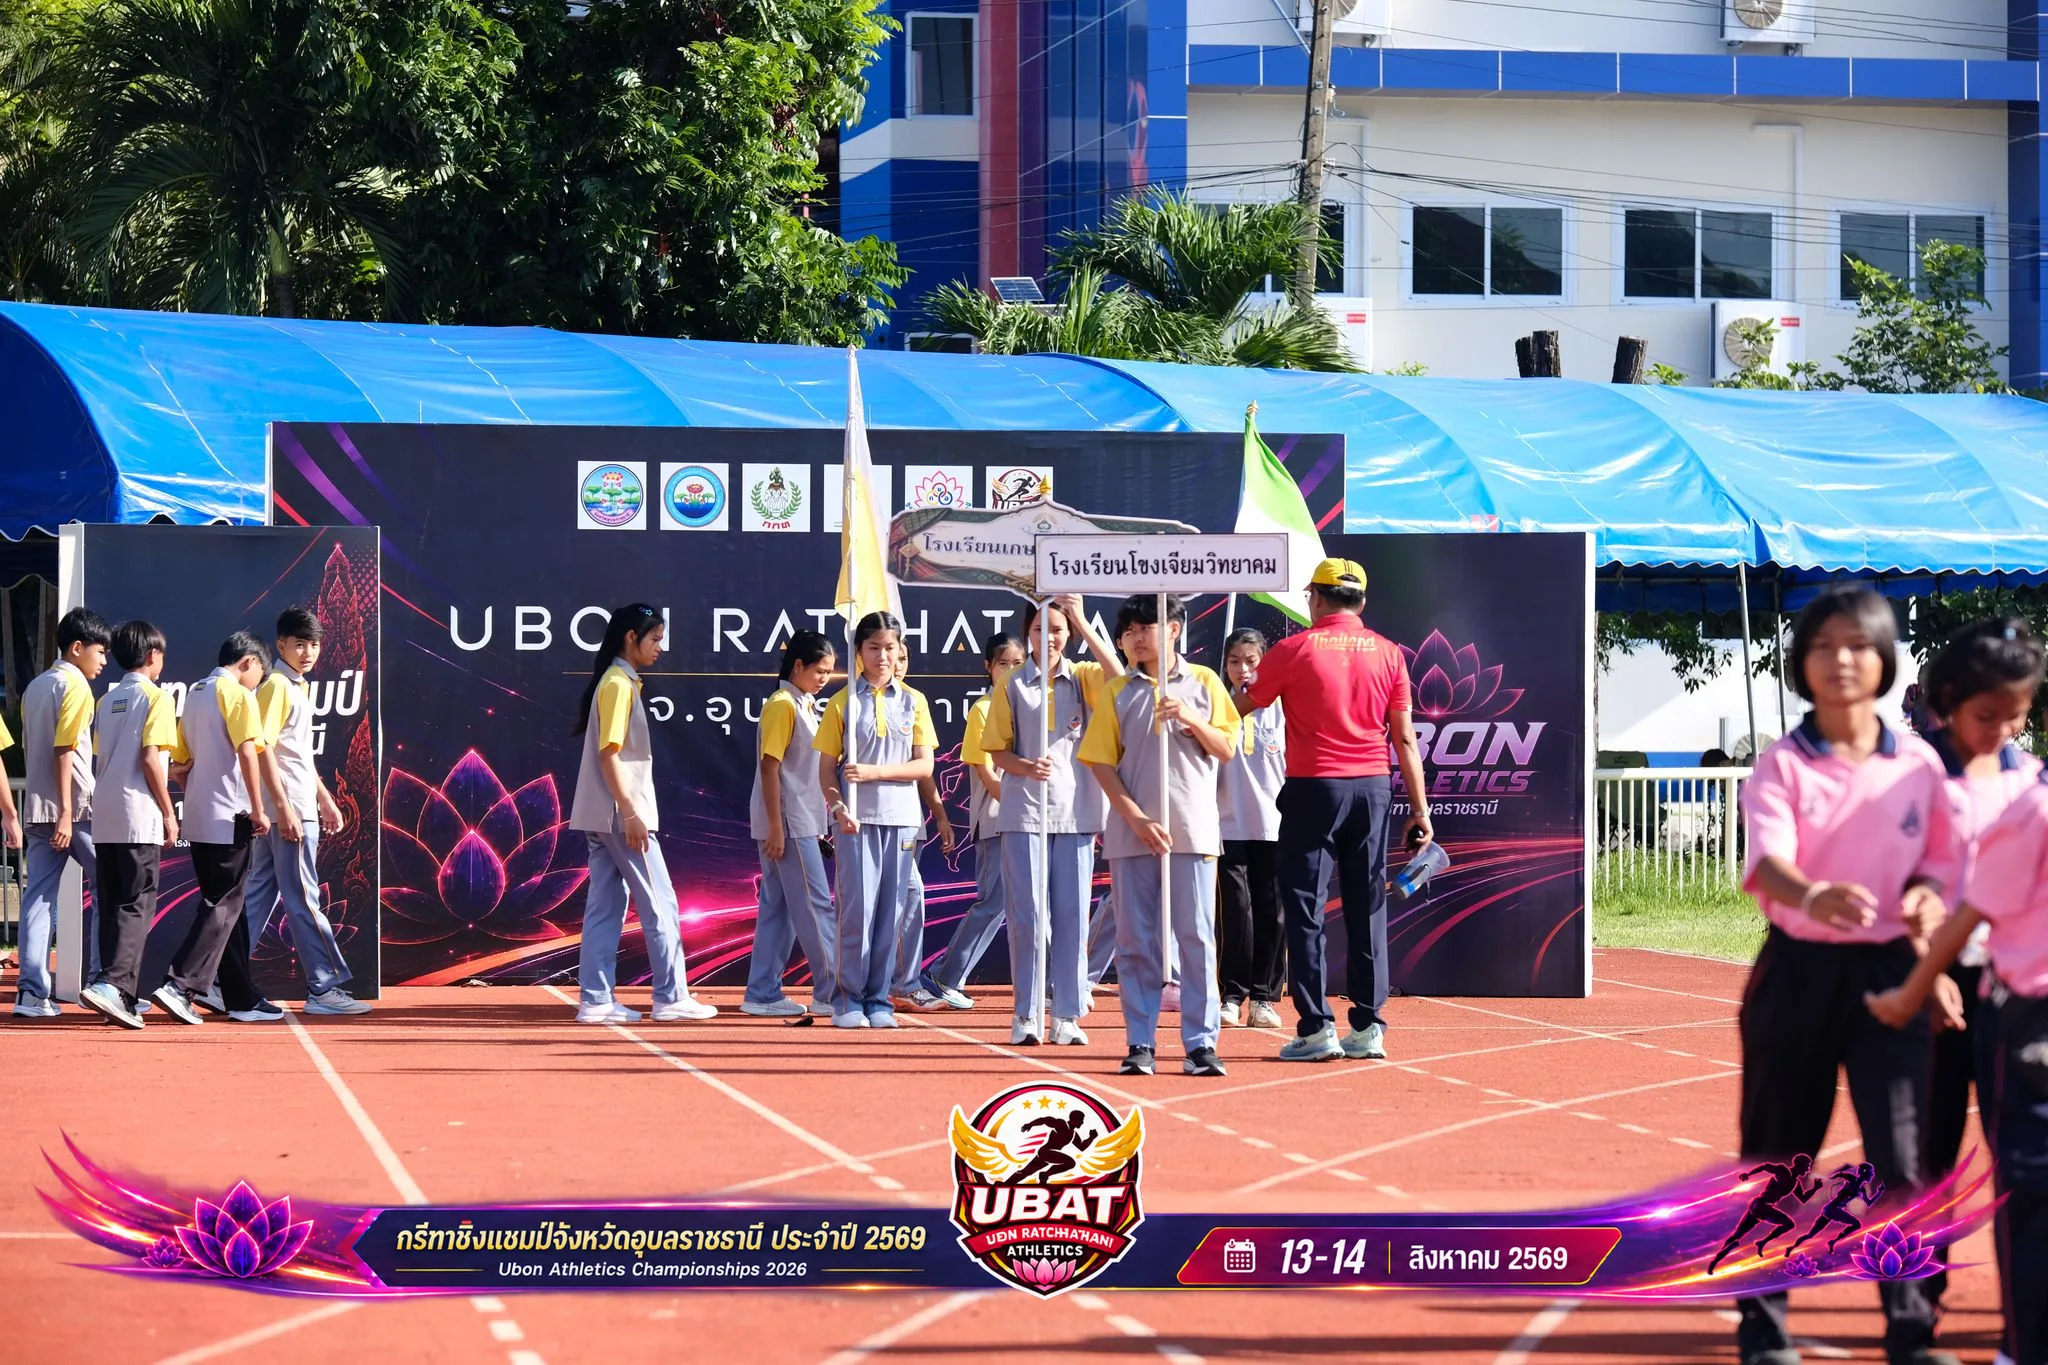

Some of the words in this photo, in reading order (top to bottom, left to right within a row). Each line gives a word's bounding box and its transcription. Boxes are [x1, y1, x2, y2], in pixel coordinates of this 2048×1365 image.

[923, 532, 1035, 556] โรงเรียนเกษ
[1049, 550, 1277, 576] โรงเรียนโขงเจียมวิทยาคม
[1386, 721, 1548, 766] BON
